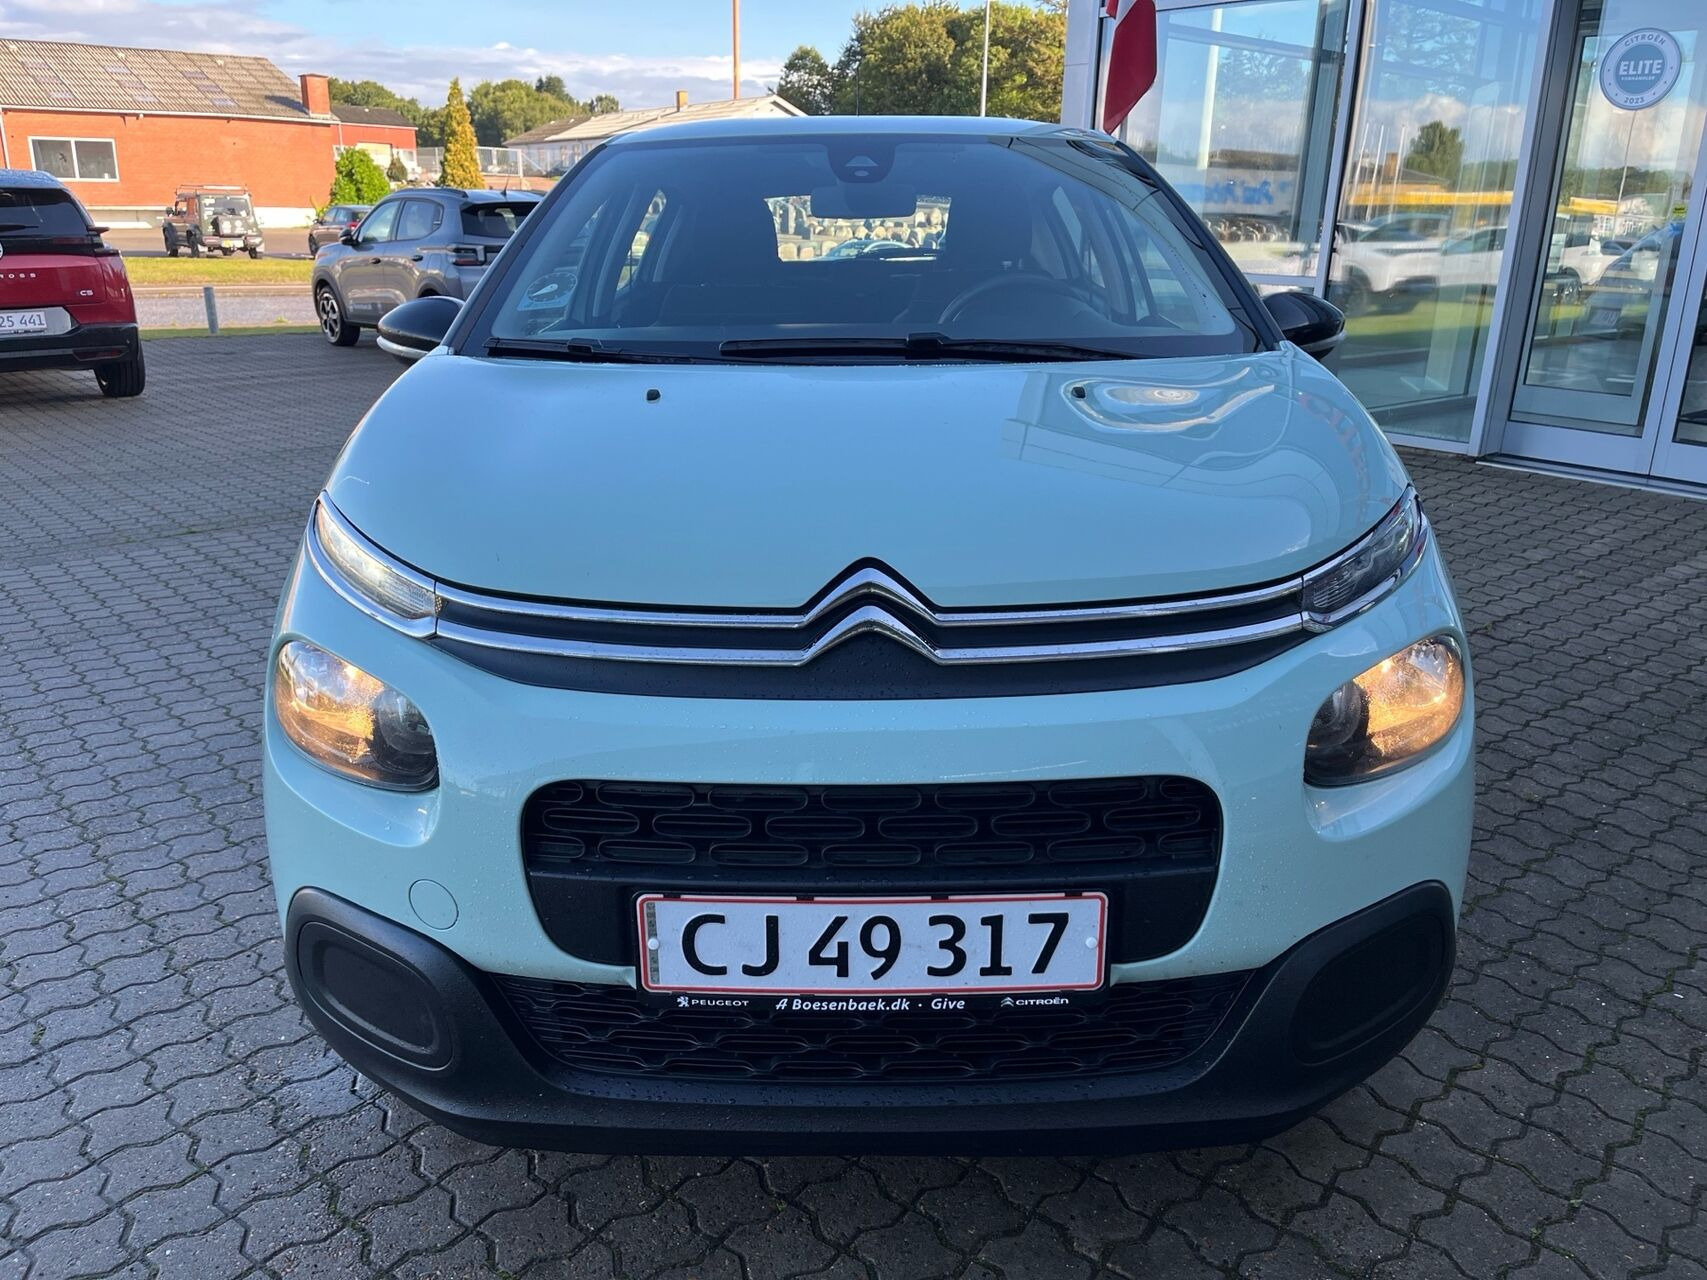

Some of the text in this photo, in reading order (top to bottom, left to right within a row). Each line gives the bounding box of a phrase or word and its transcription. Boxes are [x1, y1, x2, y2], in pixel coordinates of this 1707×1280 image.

[1619, 60, 1664, 75] ELITE
[0, 313, 46, 328] 25 441
[681, 911, 1070, 980] CJ 49 317
[691, 999, 749, 1007] PEUGEOT
[792, 998, 910, 1011] Boesenbaek.dk
[931, 998, 965, 1010] Give
